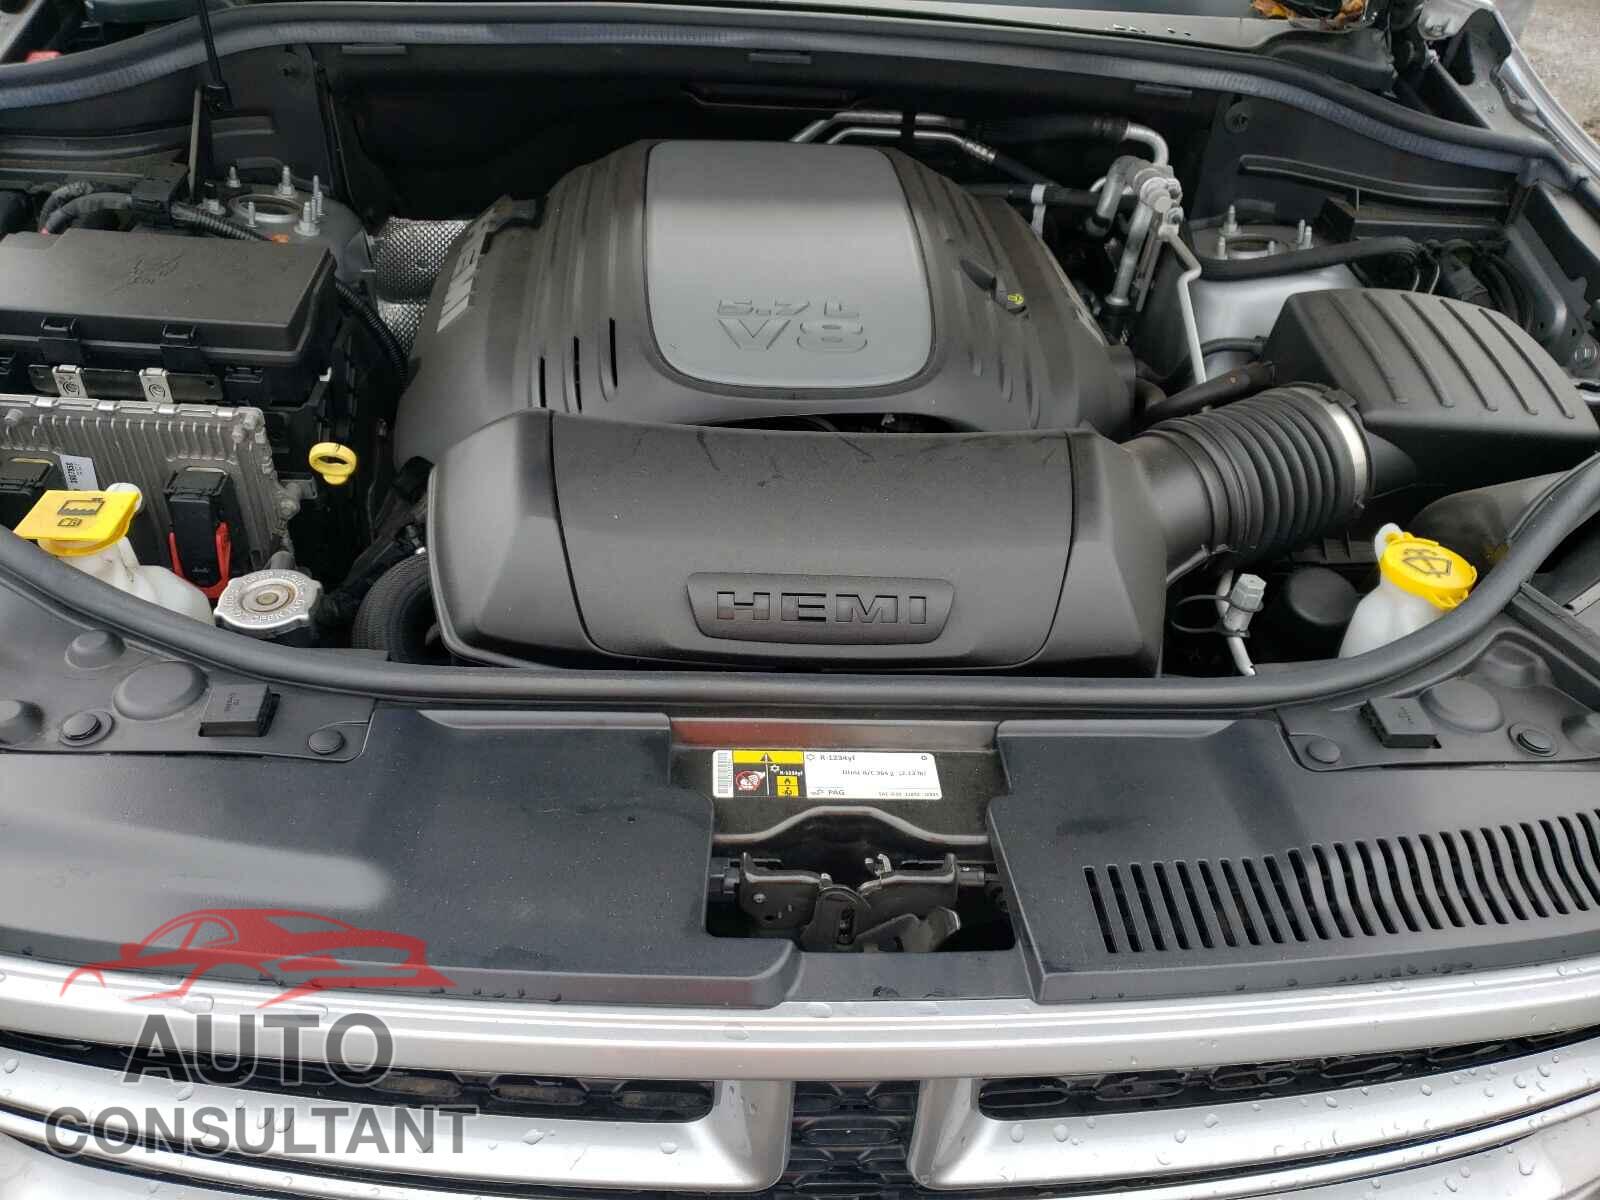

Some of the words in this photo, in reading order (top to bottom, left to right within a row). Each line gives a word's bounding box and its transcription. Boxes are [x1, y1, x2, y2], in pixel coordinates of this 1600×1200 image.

[716, 299, 860, 318] 5.7L
[717, 319, 868, 352] V8
[717, 591, 926, 625] HEMI
